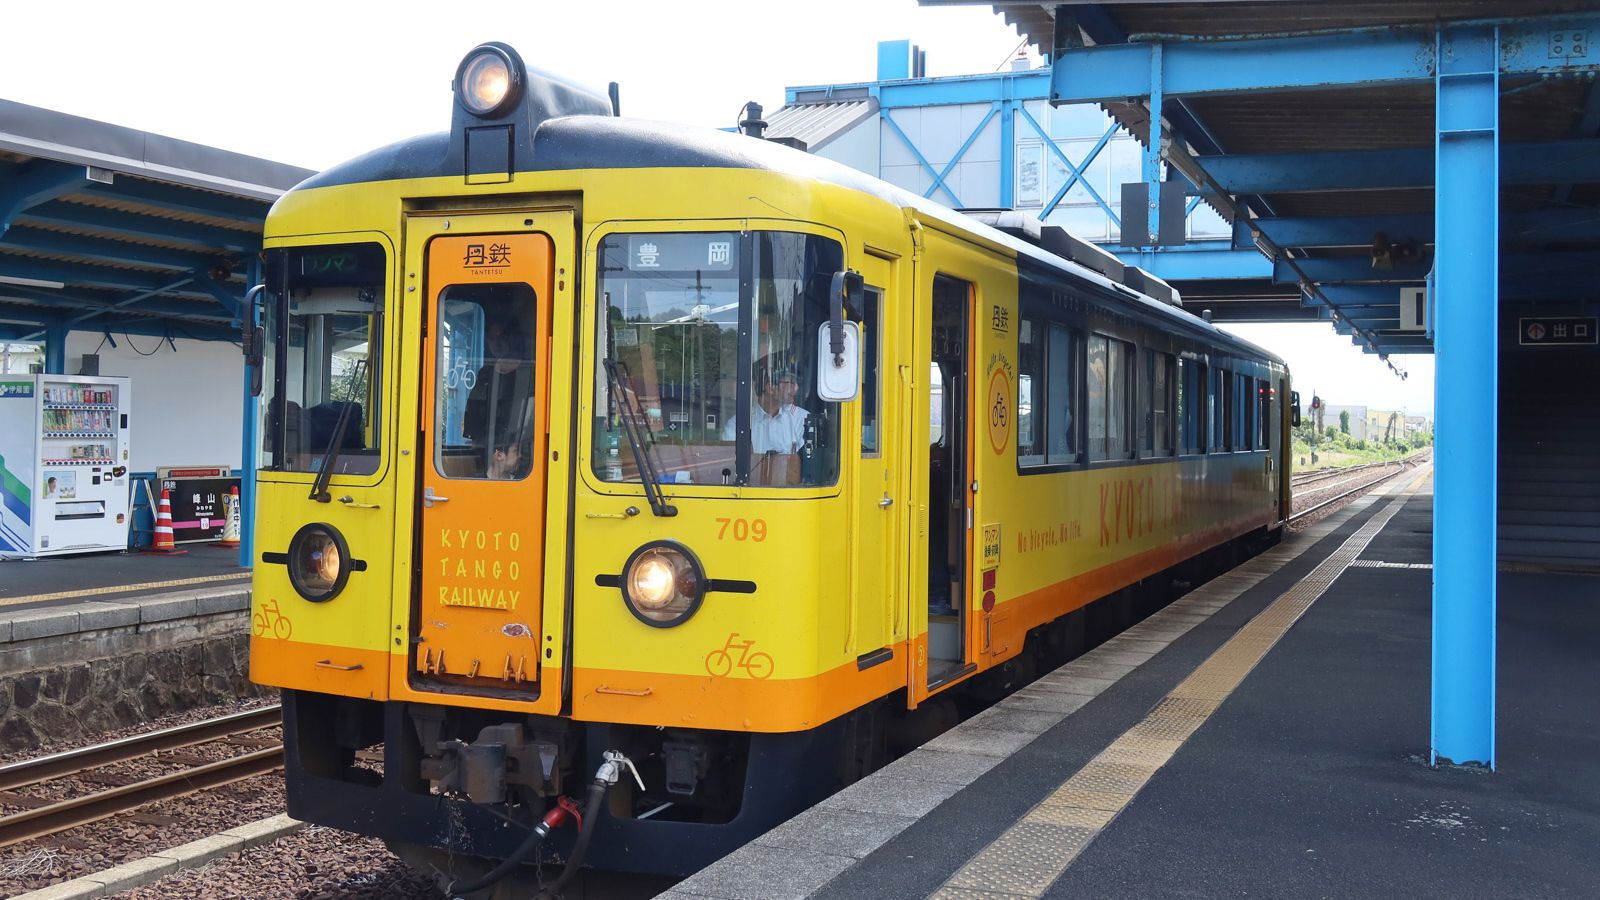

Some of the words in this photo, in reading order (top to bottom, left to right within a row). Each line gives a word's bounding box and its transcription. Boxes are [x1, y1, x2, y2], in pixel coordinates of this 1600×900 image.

[463, 243, 511, 265] 丹鉄
[1553, 323, 1587, 338] 出口
[193, 493, 215, 504] 峰山
[441, 529, 520, 551] KYOTO
[716, 518, 767, 542] 709
[440, 558, 520, 580] TANGO
[439, 586, 520, 610] RAILWAY
